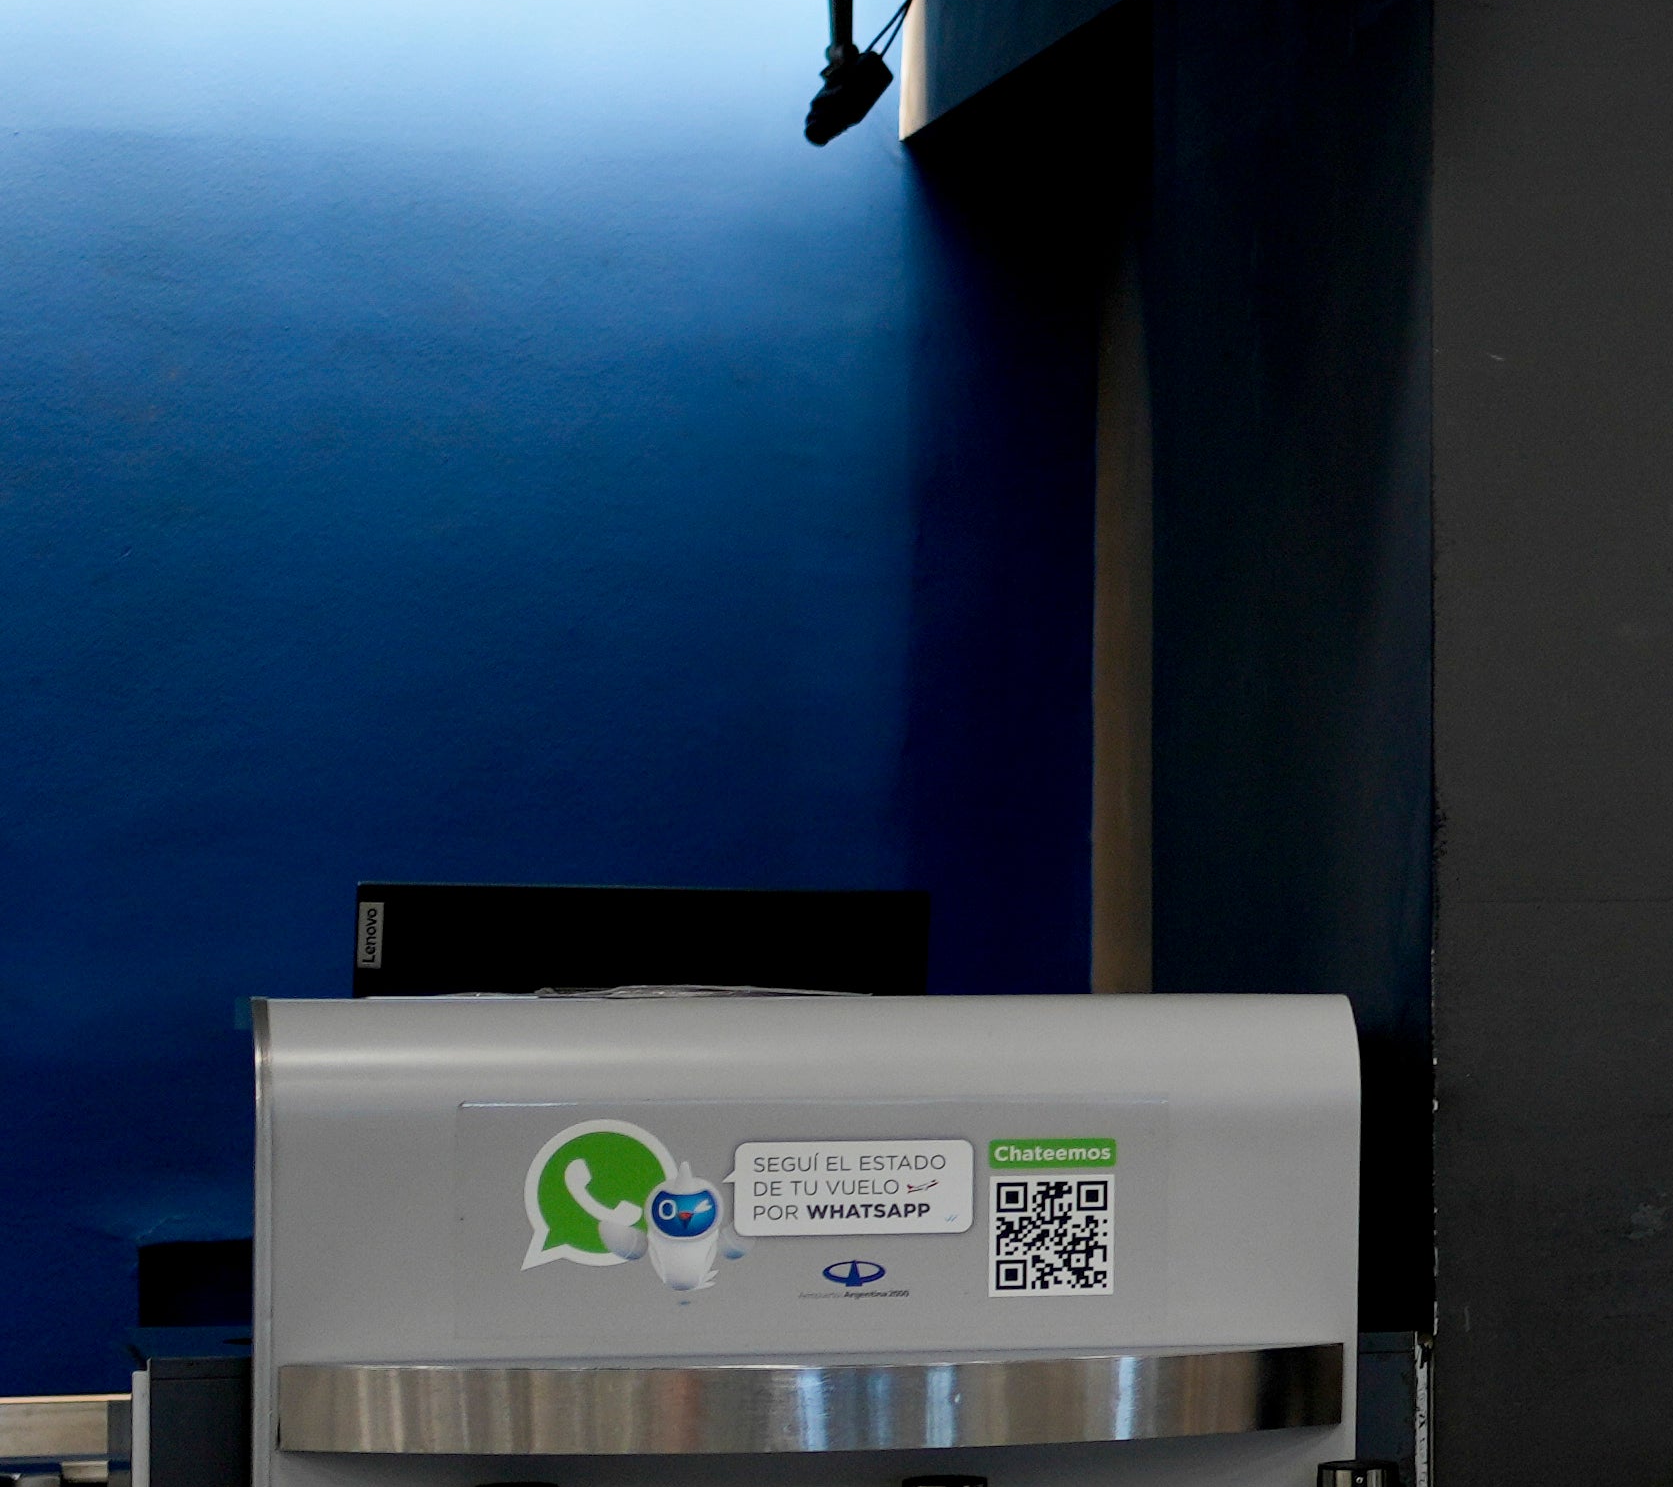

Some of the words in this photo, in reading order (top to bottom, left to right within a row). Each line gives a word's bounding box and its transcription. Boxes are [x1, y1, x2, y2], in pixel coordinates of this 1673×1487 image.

[362, 908, 378, 963] Lenovo
[753, 1152, 819, 1173] SEGUÍ
[826, 1156, 855, 1172] EL
[859, 1154, 947, 1172] ESTADO
[993, 1144, 1112, 1163] Chateemos
[753, 1180, 782, 1197] DE
[790, 1179, 819, 1197] TU
[825, 1178, 899, 1196] VUELO
[753, 1204, 798, 1221] POR
[807, 1202, 931, 1220] WHATSAPP
